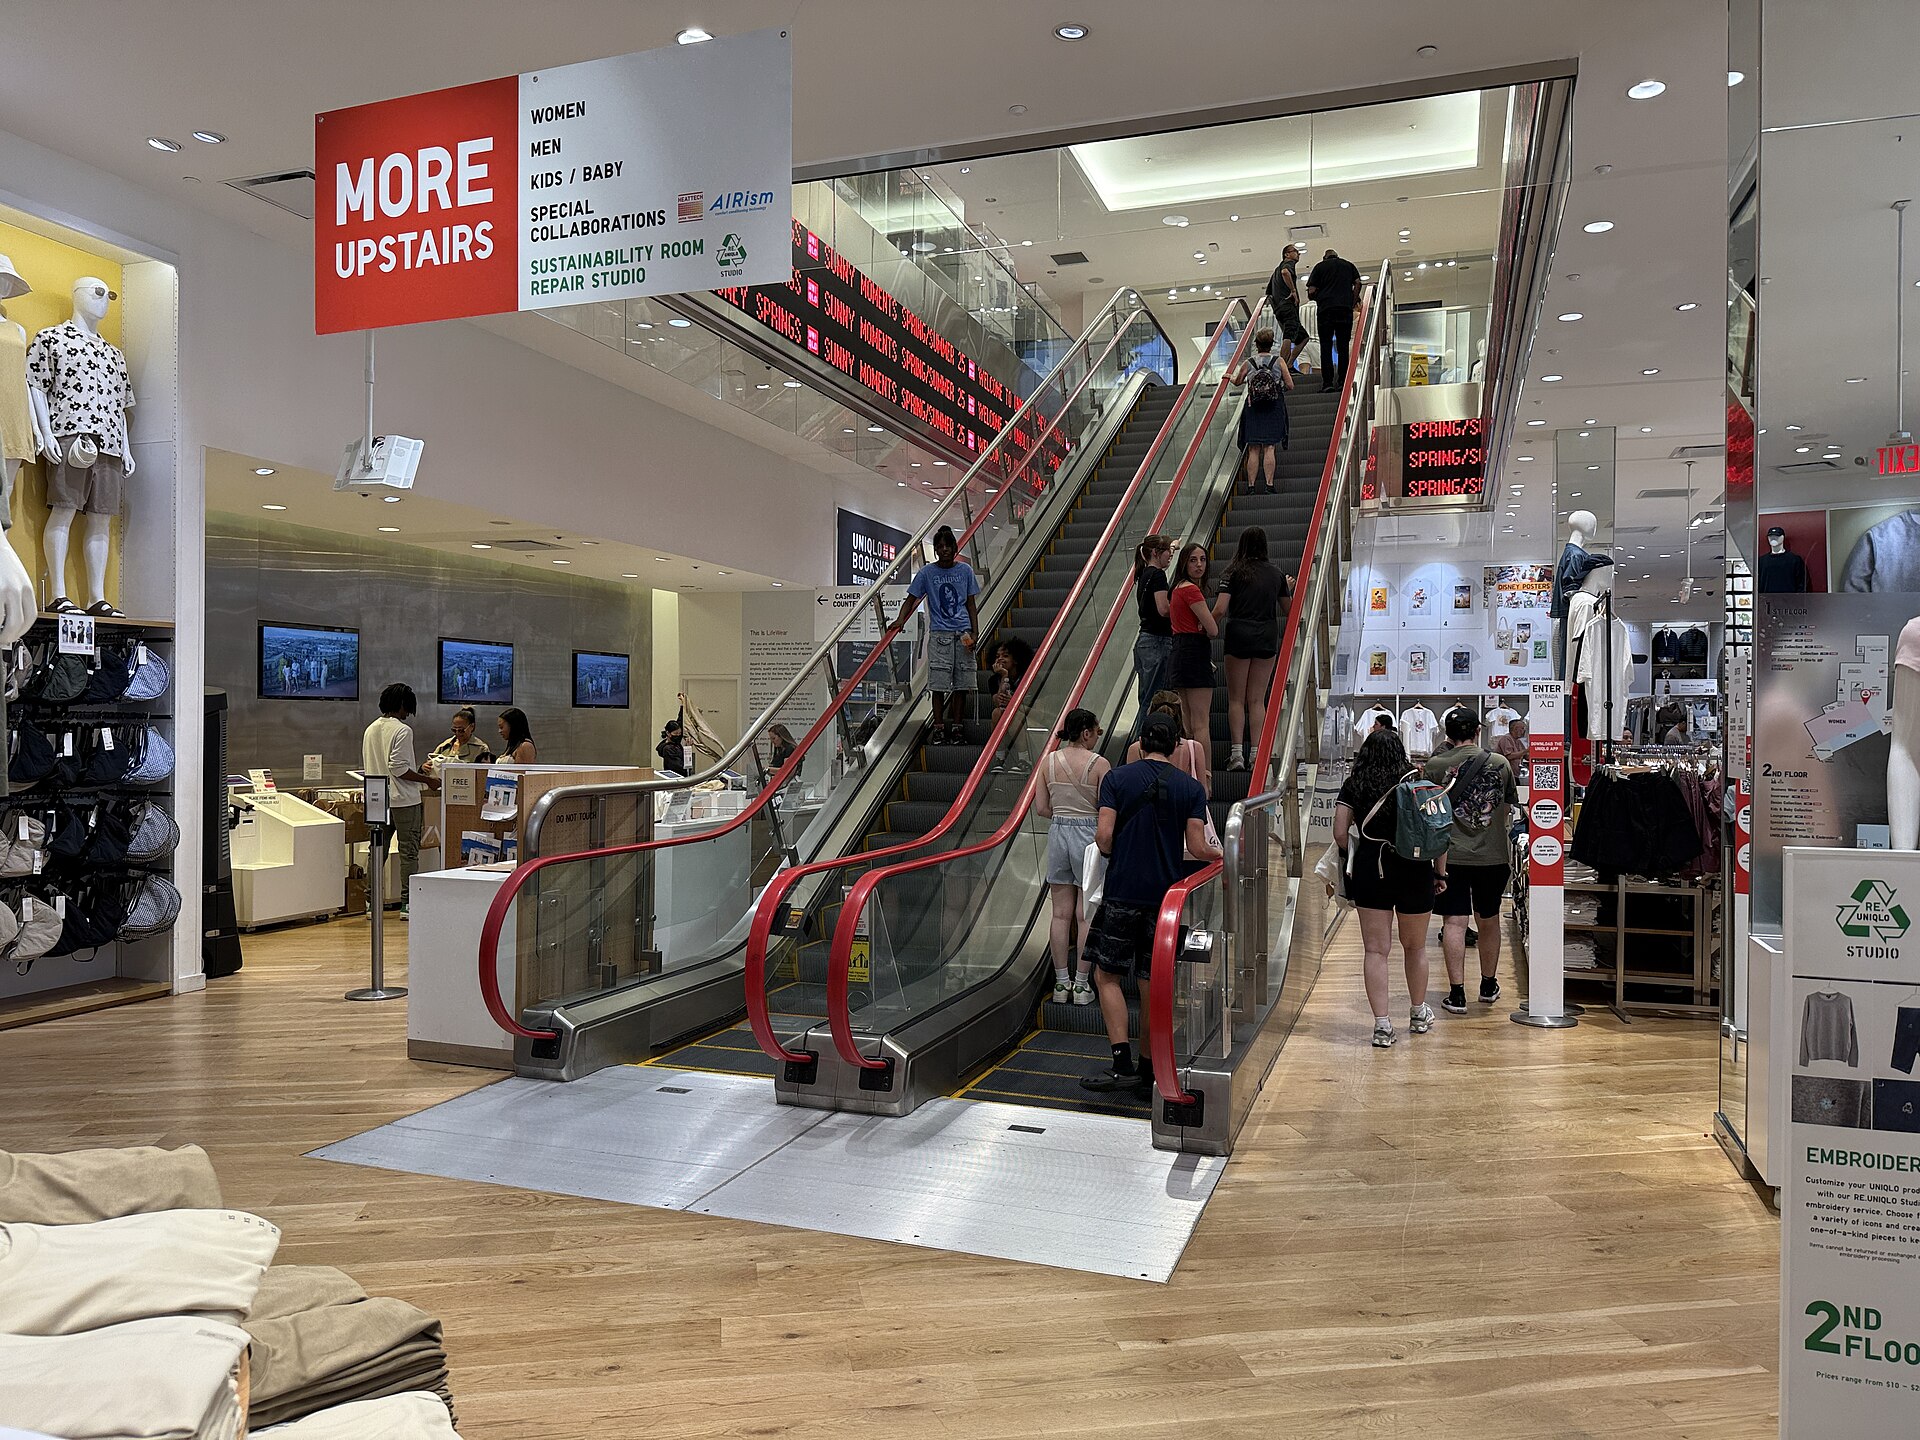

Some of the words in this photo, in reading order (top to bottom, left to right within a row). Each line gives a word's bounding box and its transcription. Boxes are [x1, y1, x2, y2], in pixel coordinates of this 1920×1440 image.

[531, 101, 586, 124] WOMEN
[531, 138, 561, 158] MEN
[336, 137, 494, 226] MORE
[531, 170, 562, 190] KIDS
[570, 168, 576, 184] /
[583, 161, 623, 182] BABY
[678, 194, 703, 202] HEATTECH
[709, 191, 774, 211] AIRism
[531, 200, 594, 222] SPECIAL
[531, 210, 666, 242] COLLABORATIONS
[336, 220, 494, 279] UPSTAIRS
[531, 245, 653, 275] SUSTAINABILITY
[661, 239, 704, 260] ROOM
[531, 275, 584, 296] REPAIR
[592, 268, 646, 289] STUDIO
[720, 269, 742, 277] STUDIO
[825, 245, 855, 288] SUNNY
[860, 272, 897, 321] MOMENTS
[902, 307, 954, 365] SPRING/SUMMER
[978, 367, 1002, 402] WELCOME
[756, 292, 801, 344] SPRINGS
[825, 336, 855, 376] SUNNY
[860, 360, 897, 403] MOMENTS
[902, 388, 954, 438] SPRING/SUMMER
[825, 291, 855, 332] SUNNY
[860, 316, 898, 362] MOMENTS
[902, 347, 954, 402] SPRING/SUMMER
[978, 401, 1002, 433] WELCOME
[1410, 418, 1481, 439] SPRING/S
[1409, 448, 1481, 467] SPRING/S
[853, 533, 882, 557] UNIQLO
[853, 552, 889, 575] BOOKSH
[1489, 676, 1508, 689] UT
[1762, 764, 1782, 777] 2ND
[556, 814, 564, 823] DO
[565, 813, 578, 823] NOT
[579, 810, 597, 821] TOUCH
[1857, 912, 1890, 922] UNIQLO
[1865, 902, 1884, 912] RE.
[1847, 946, 1899, 959] STUDIO
[1807, 1146, 1920, 1172] EMBROIDER
[1806, 1176, 1845, 1186] Customize
[1870, 1183, 1899, 1192] UNIQLO
[1854, 1194, 1897, 1204] RE.UNIQLO
[1806, 1201, 1850, 1213] embroidery
[1853, 1207, 1883, 1216] service.
[1886, 1210, 1914, 1218] Choose
[1821, 1216, 1848, 1225] variety
[1810, 1227, 1868, 1238] one-of-a-kind
[1872, 1233, 1895, 1241] pieces
[1840, 1252, 1869, 1260] embroidery
[1872, 1256, 1900, 1264] processing
[1805, 1300, 1881, 1354] 2ND
[1846, 1335, 1920, 1365] FLOO
[1816, 1371, 1838, 1380] Prices
[1842, 1376, 1862, 1384] range
[1865, 1378, 1883, 1386] from
[1886, 1381, 1899, 1389] $10
